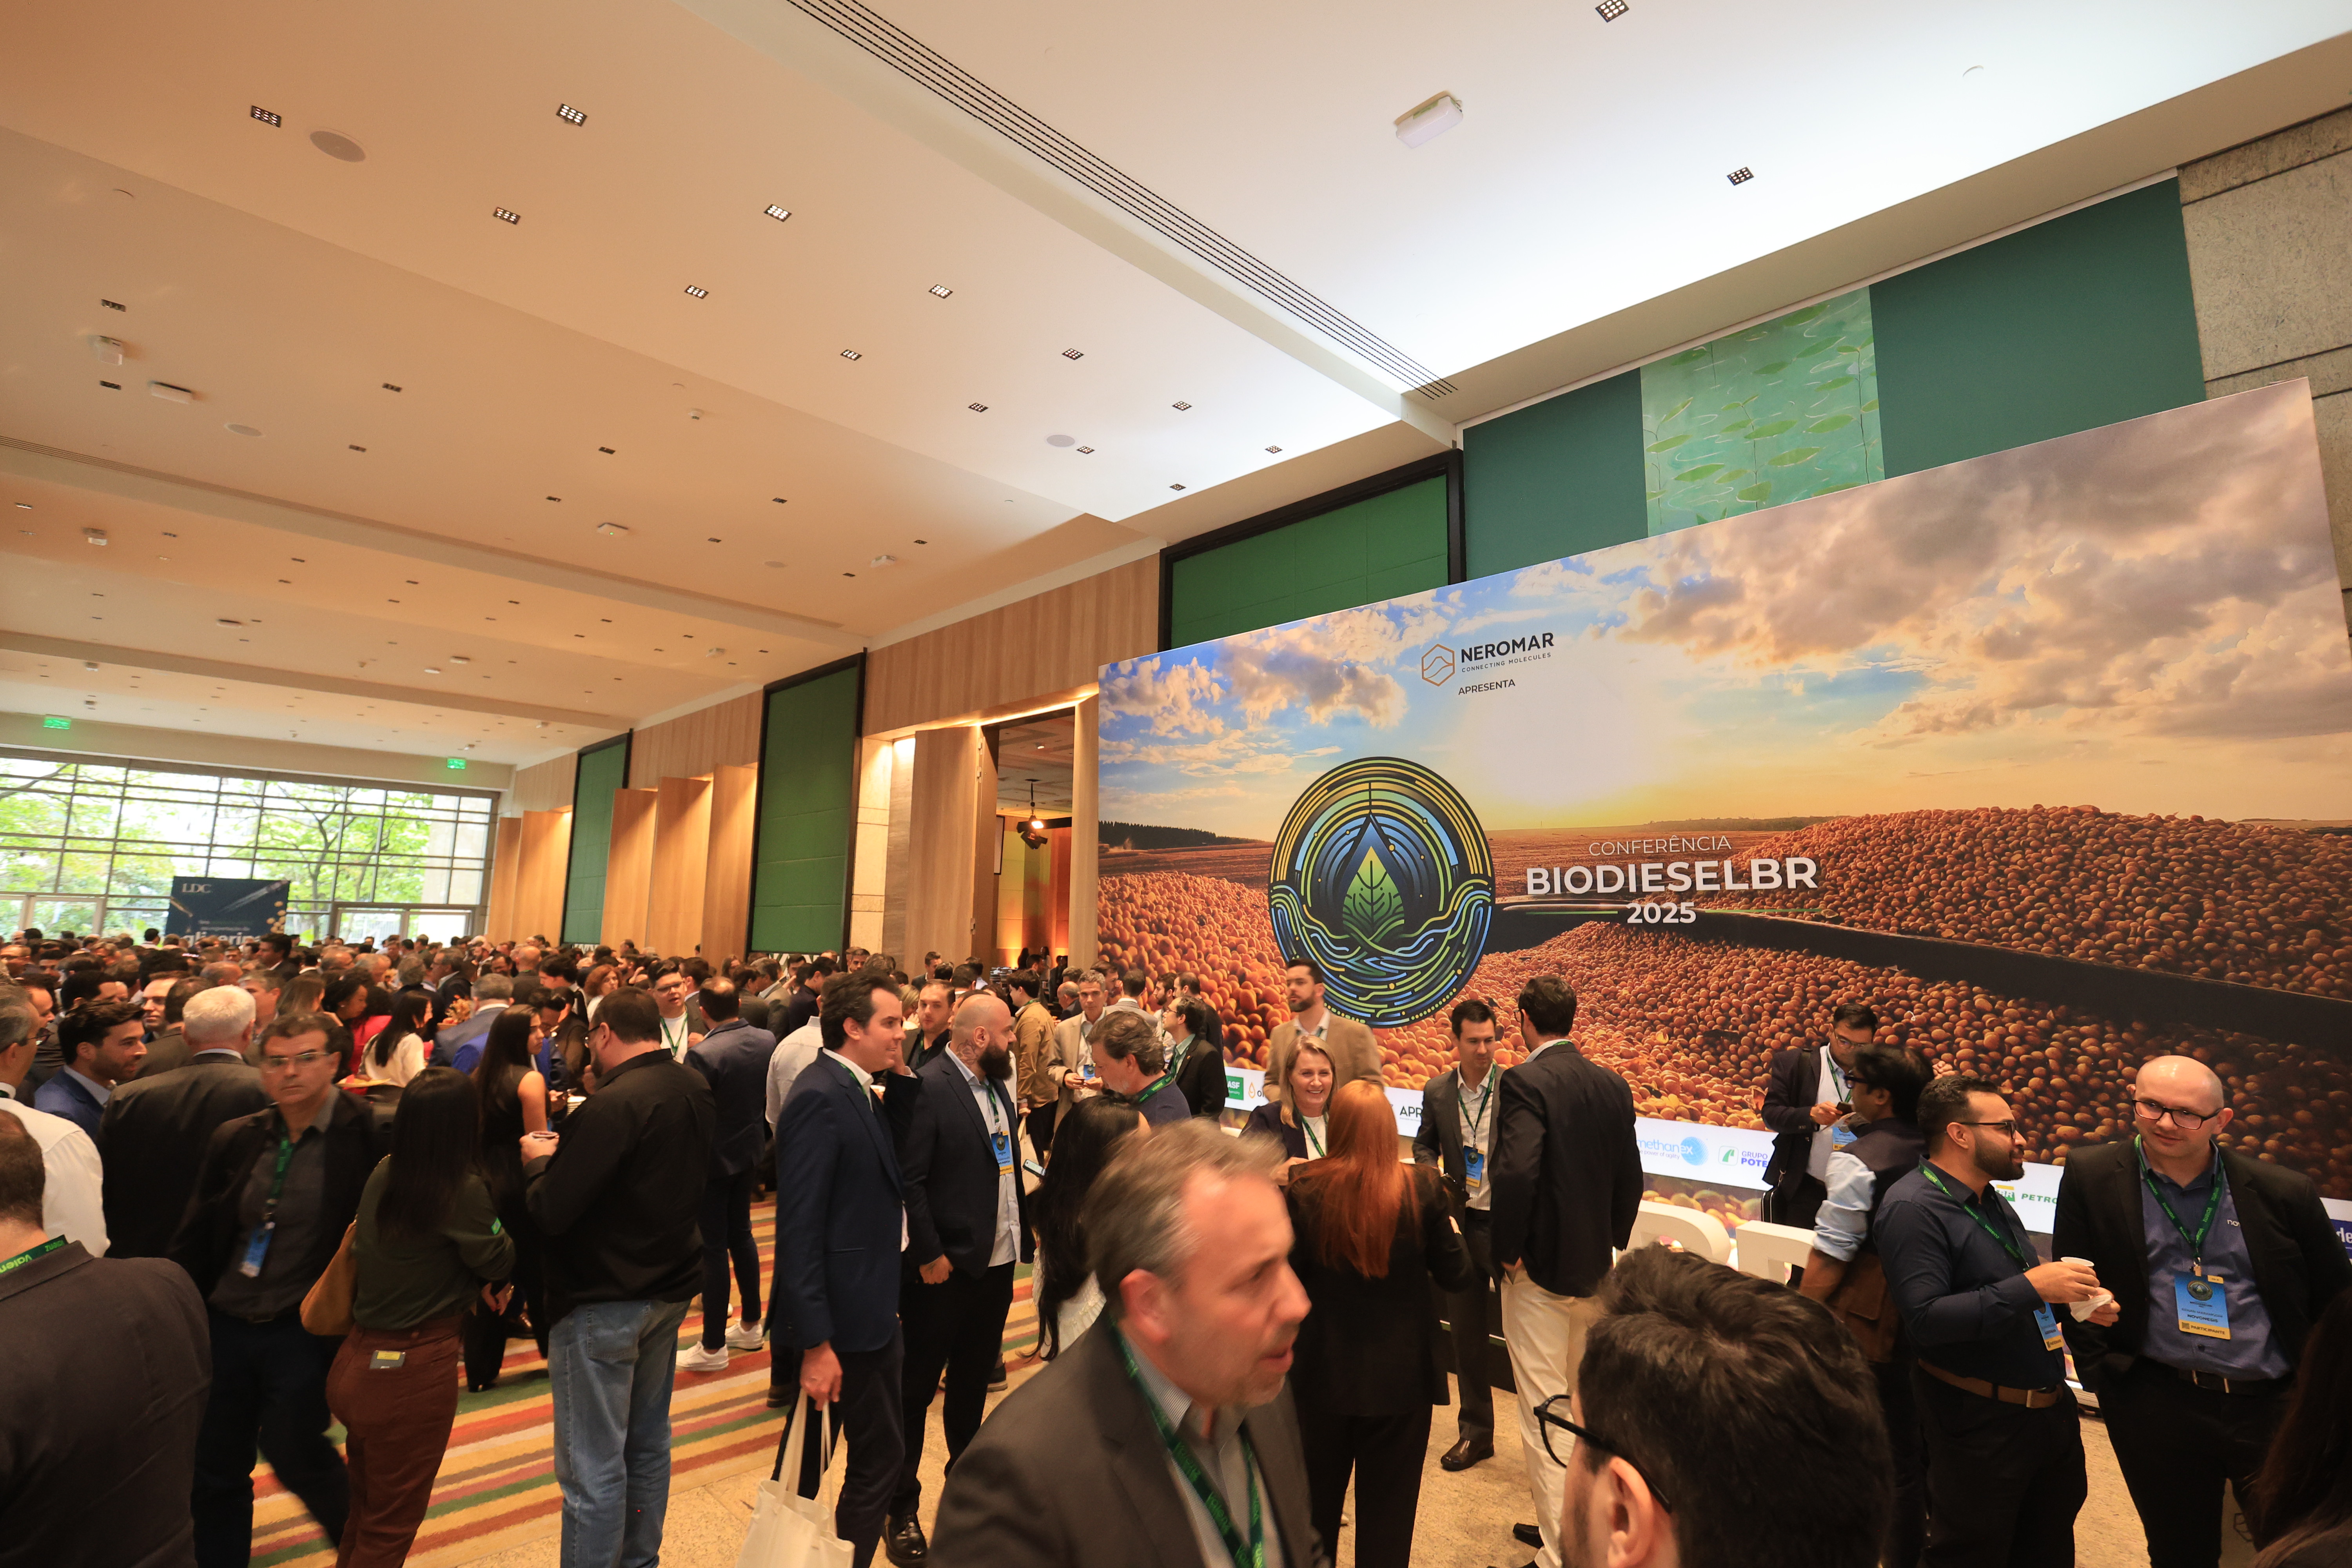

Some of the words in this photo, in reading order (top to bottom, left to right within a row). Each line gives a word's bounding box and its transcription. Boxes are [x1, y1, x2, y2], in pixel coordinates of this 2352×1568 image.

[1461, 632, 1554, 663] NEROMAR
[1462, 661, 1505, 672] CONNECTING
[1509, 652, 1551, 664] MOLECULES
[1458, 679, 1515, 695] APRESENTA
[1589, 835, 1732, 856] CONFERÊNCIA
[1526, 857, 1818, 895] BIODIESELBR
[182, 883, 212, 893] LDC
[1626, 902, 1697, 923] 2025
[1227, 1081, 1240, 1089] ASF
[1399, 1106, 1423, 1118] APR
[1637, 1139, 1693, 1155] methanex
[1741, 1158, 1768, 1167] POTE
[1742, 1151, 1768, 1160] GRUPO
[2021, 1193, 2058, 1204] PETRO
